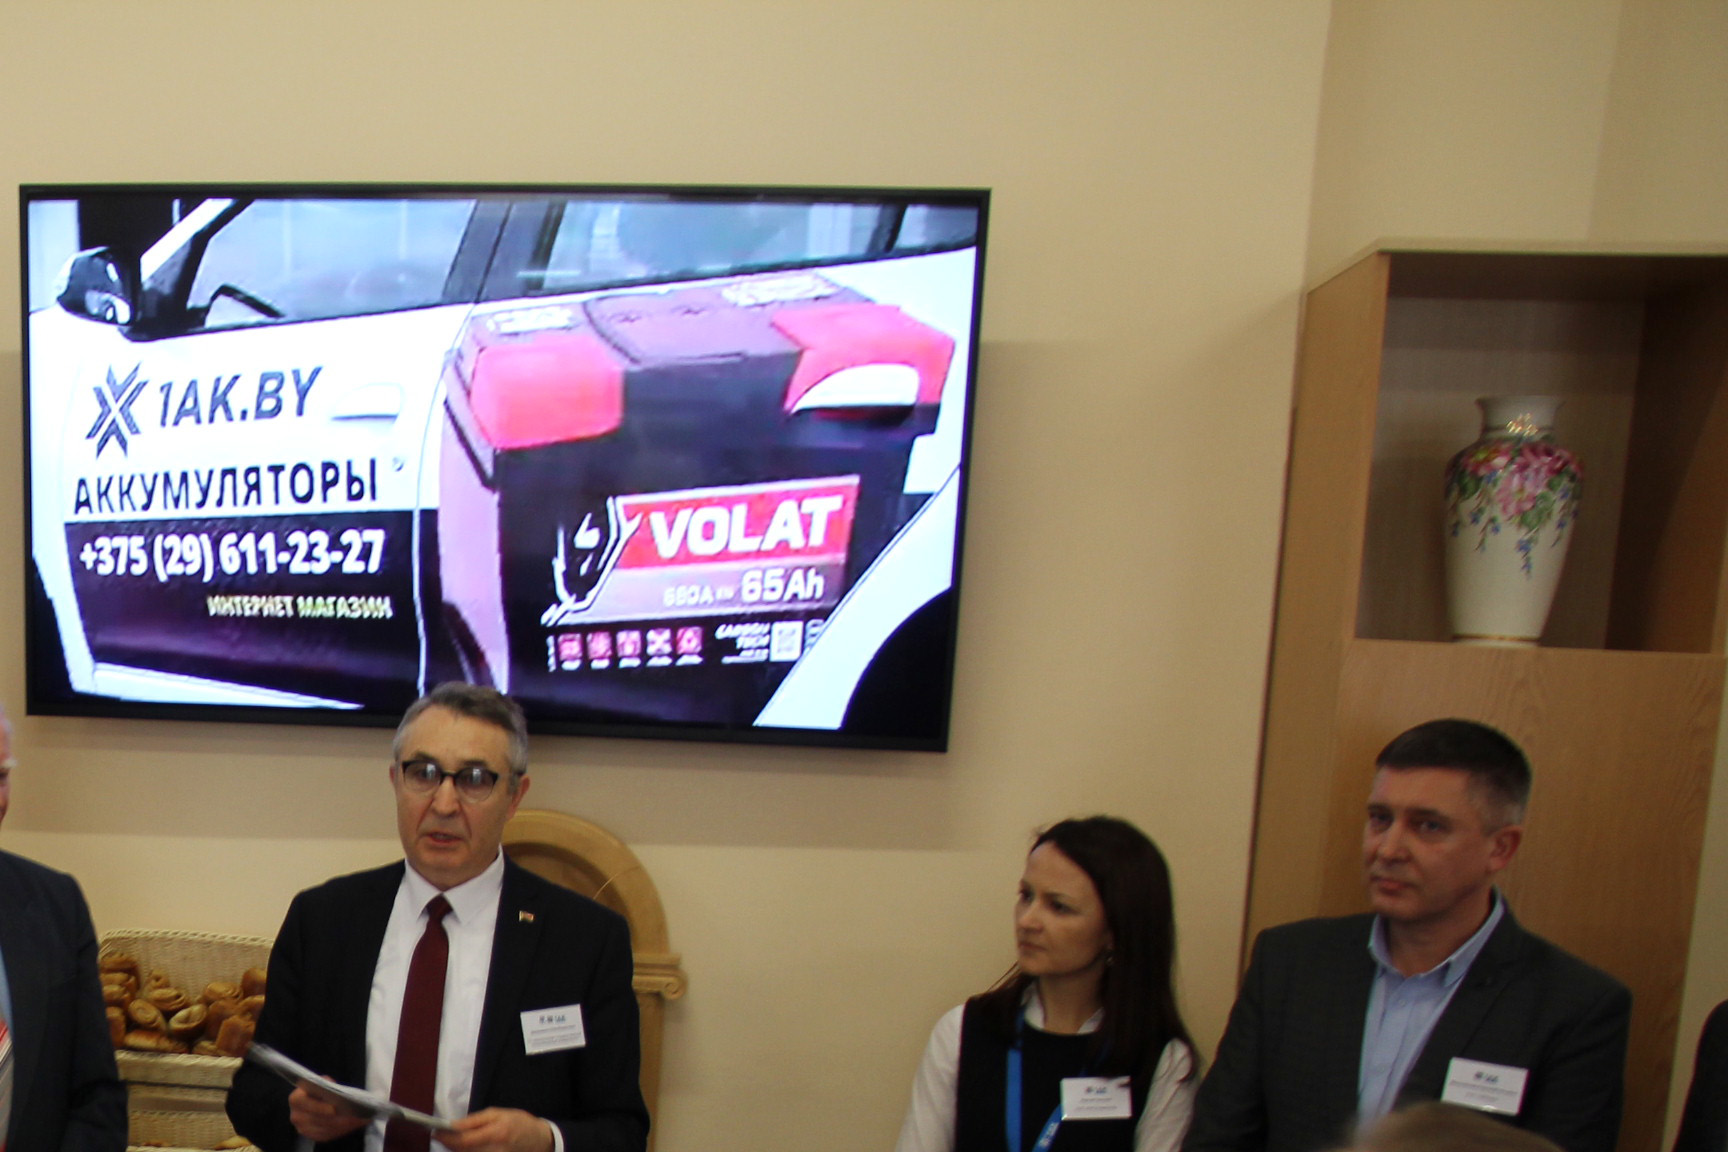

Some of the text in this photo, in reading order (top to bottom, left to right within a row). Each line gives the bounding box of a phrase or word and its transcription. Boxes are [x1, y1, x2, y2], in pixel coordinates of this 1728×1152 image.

[159, 366, 323, 427] 1AK.BY
[74, 458, 376, 515] АККУМУЛЯТОРЫ
[650, 495, 844, 559] VOLAT
[80, 528, 385, 583] +375 (29) 611-23-27
[206, 595, 393, 619] ИНТЕРНЕТ МАГАЗИН
[741, 567, 825, 602] 65Ah
